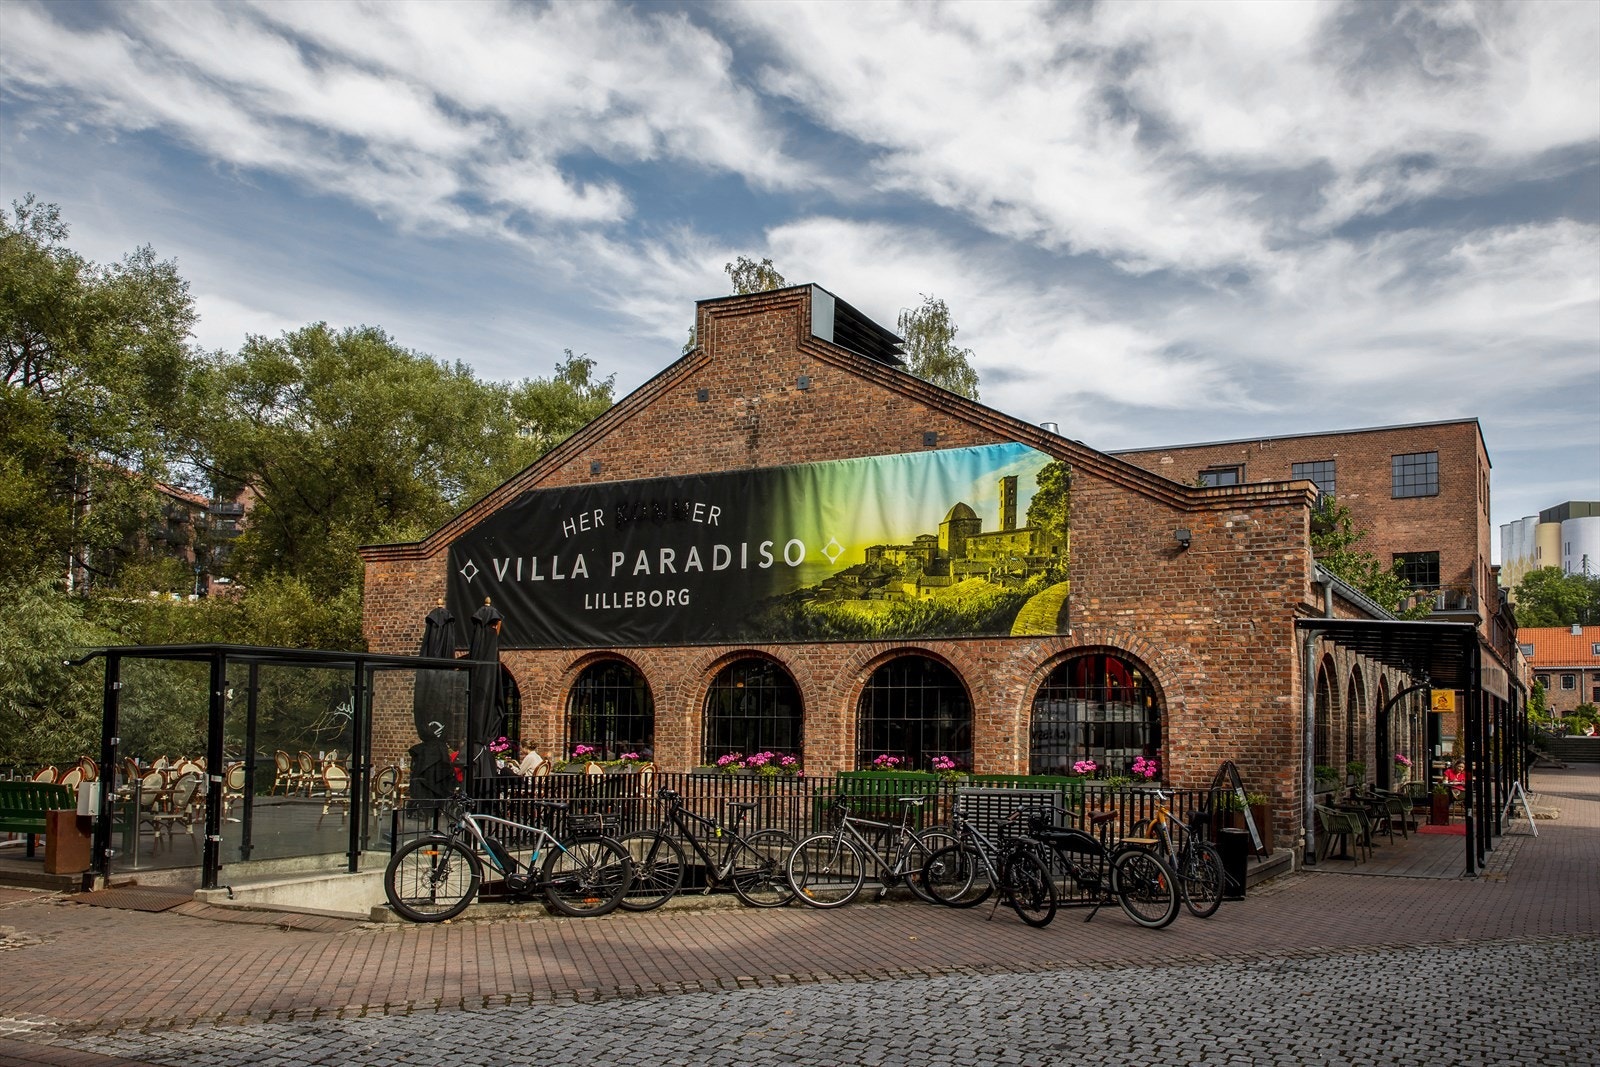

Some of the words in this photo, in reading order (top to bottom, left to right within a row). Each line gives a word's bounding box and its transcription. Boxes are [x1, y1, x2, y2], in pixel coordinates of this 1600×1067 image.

[562, 508, 605, 538] HER
[491, 553, 590, 583] VILLA
[610, 538, 808, 577] PARADISO
[583, 588, 691, 610] LILLEBORG
